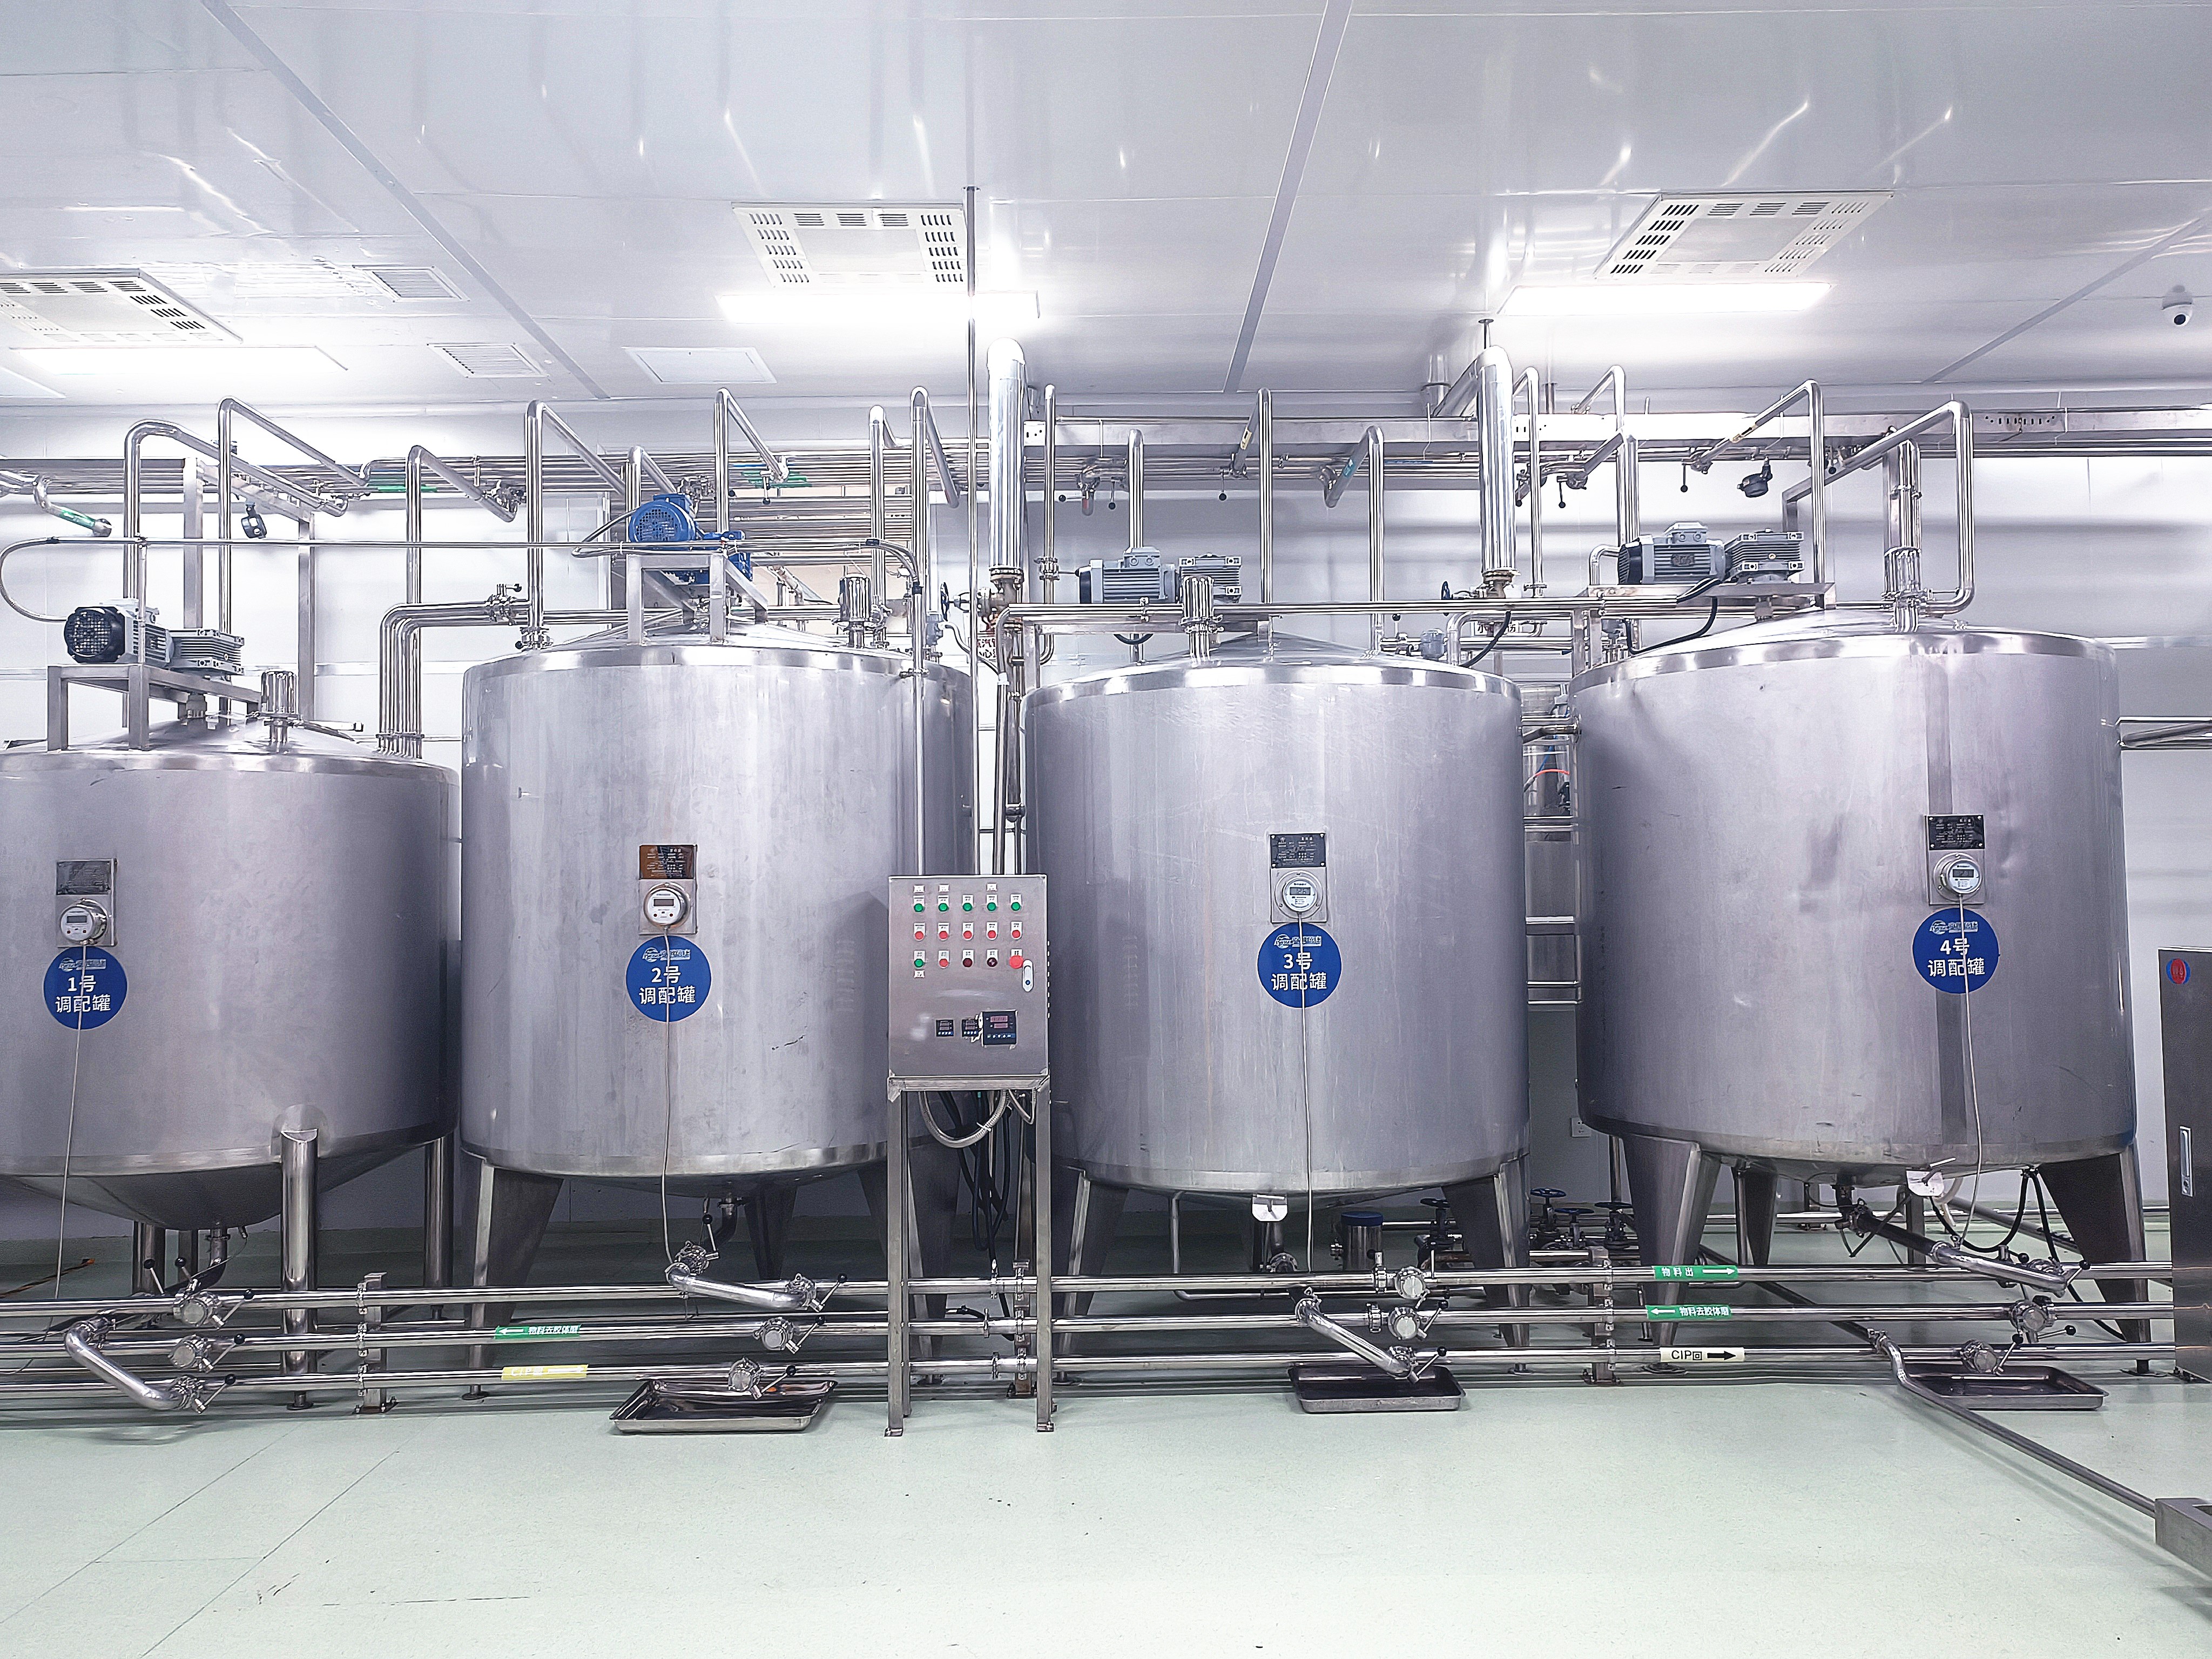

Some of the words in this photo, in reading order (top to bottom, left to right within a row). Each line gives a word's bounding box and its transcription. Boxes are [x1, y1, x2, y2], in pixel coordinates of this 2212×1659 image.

[1939, 938, 1970, 956] 4号
[1283, 952, 1313, 970] 3号
[1927, 957, 1986, 977] 调配罐
[67, 975, 97, 992] 1号
[651, 966, 682, 983] 2号
[1271, 972, 1327, 991] 调配罐
[55, 994, 111, 1013] 调配罐
[638, 986, 696, 1005] 调配罐
